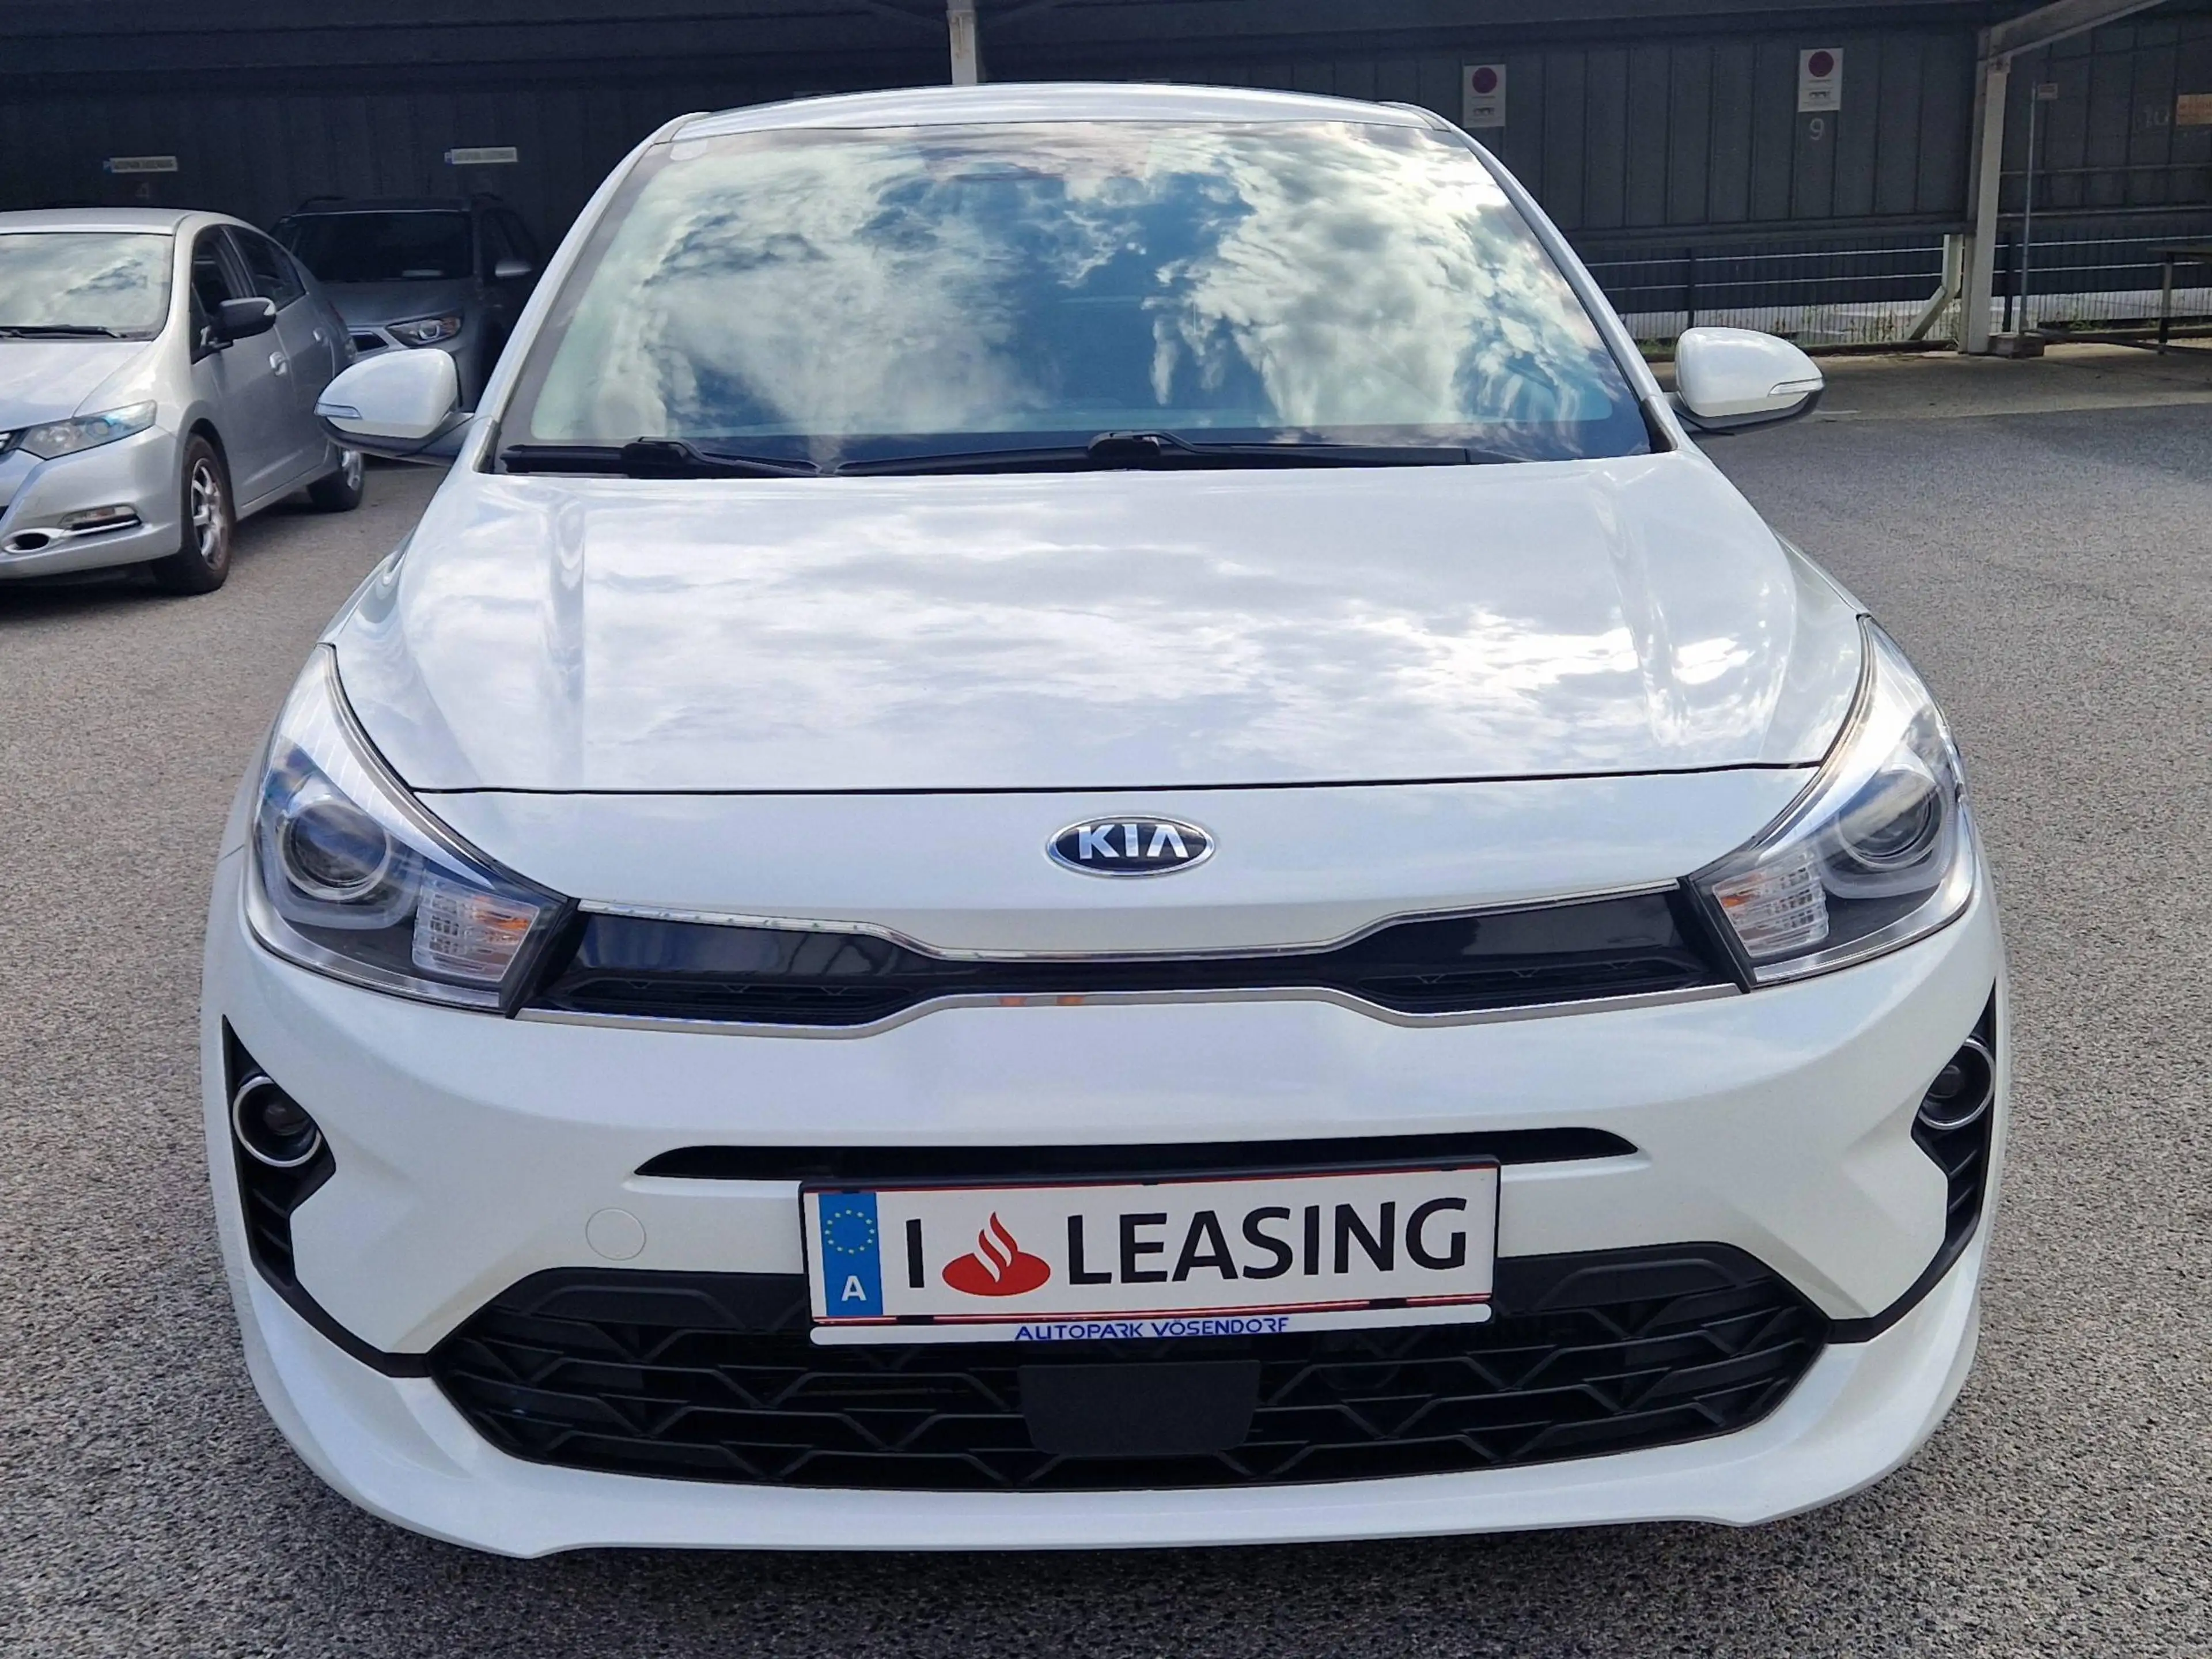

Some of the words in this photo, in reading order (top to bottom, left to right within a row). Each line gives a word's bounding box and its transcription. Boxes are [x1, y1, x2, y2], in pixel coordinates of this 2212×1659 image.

[1809, 117, 1825, 141] 9
[1076, 824, 1190, 860] KIA
[906, 1218, 925, 1288] I
[1067, 1197, 1467, 1285] LEASING
[842, 1275, 866, 1301] A
[1014, 1323, 1143, 1342] AUTOPARK
[1152, 1317, 1289, 1338] VÖSENDORF
